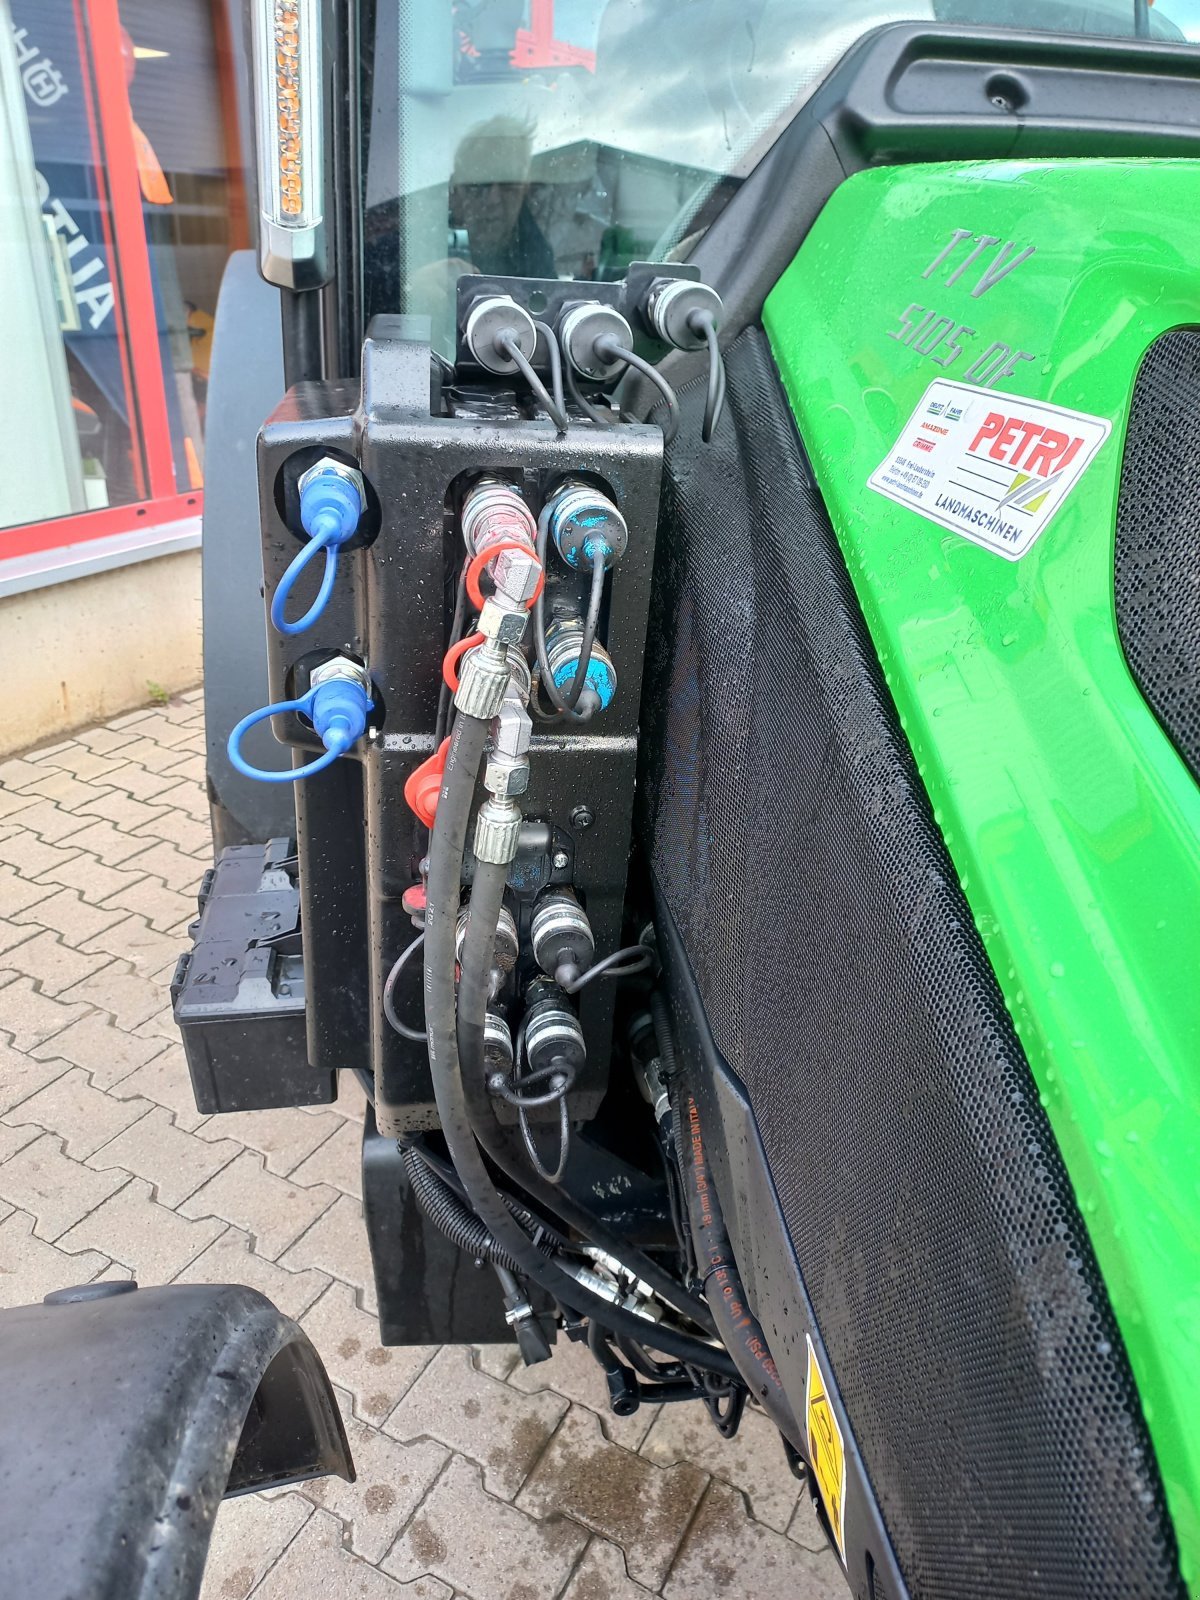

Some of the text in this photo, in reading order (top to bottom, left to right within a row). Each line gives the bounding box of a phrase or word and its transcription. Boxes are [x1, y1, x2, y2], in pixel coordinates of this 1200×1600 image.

[921, 228, 1036, 298] TTV
[886, 303, 1036, 388] 5105 DF
[950, 407, 963, 415] FAHR
[920, 422, 949, 435] AMAZONE
[912, 440, 934, 453] GRIMME
[968, 411, 1085, 478] PETRI
[934, 494, 1023, 543] LANDMASCHINEN
[447, 729, 462, 771] Engineered
[688, 1097, 699, 1122] ITALY
[690, 1123, 700, 1135] IN
[692, 1136, 704, 1165] MADE
[701, 1193, 711, 1212] mm
